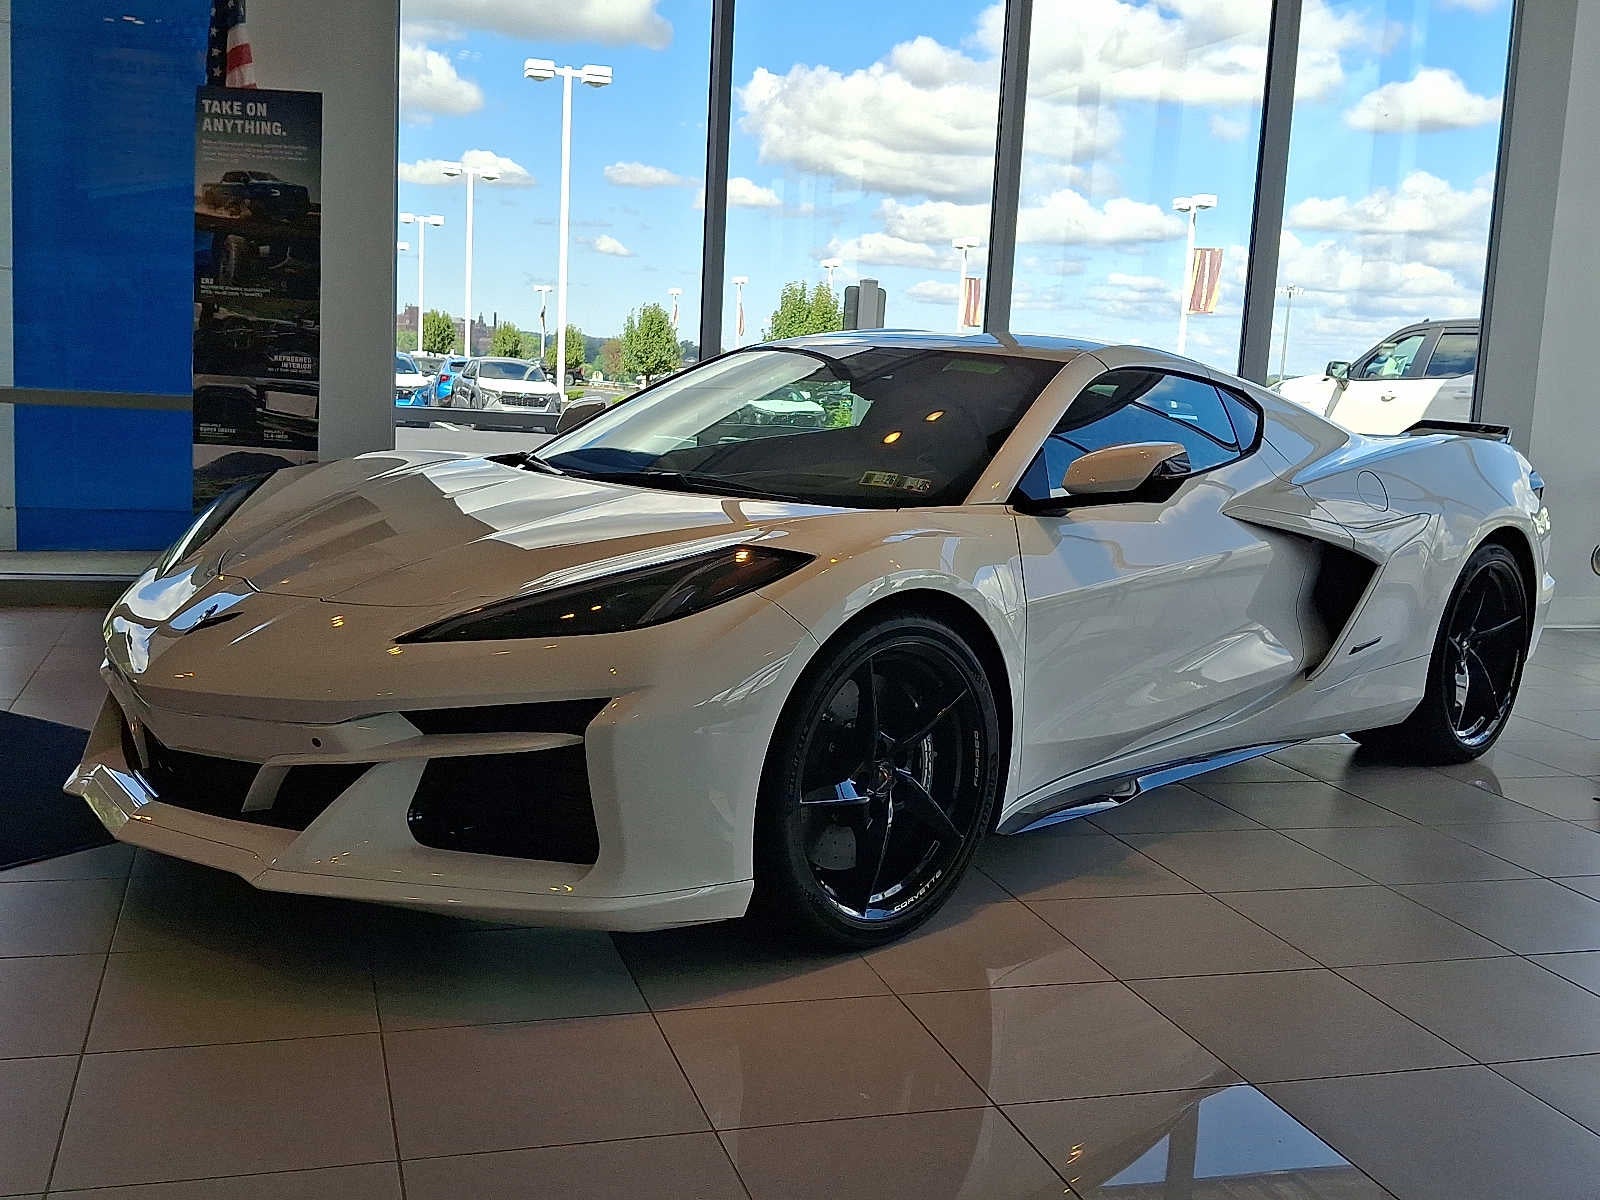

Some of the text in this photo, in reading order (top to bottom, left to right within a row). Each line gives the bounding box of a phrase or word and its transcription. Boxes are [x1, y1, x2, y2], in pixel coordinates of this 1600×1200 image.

[201, 99, 267, 117] TAKE ON
[202, 118, 287, 136] ANYTHING.
[893, 868, 943, 912] CORVETTE
